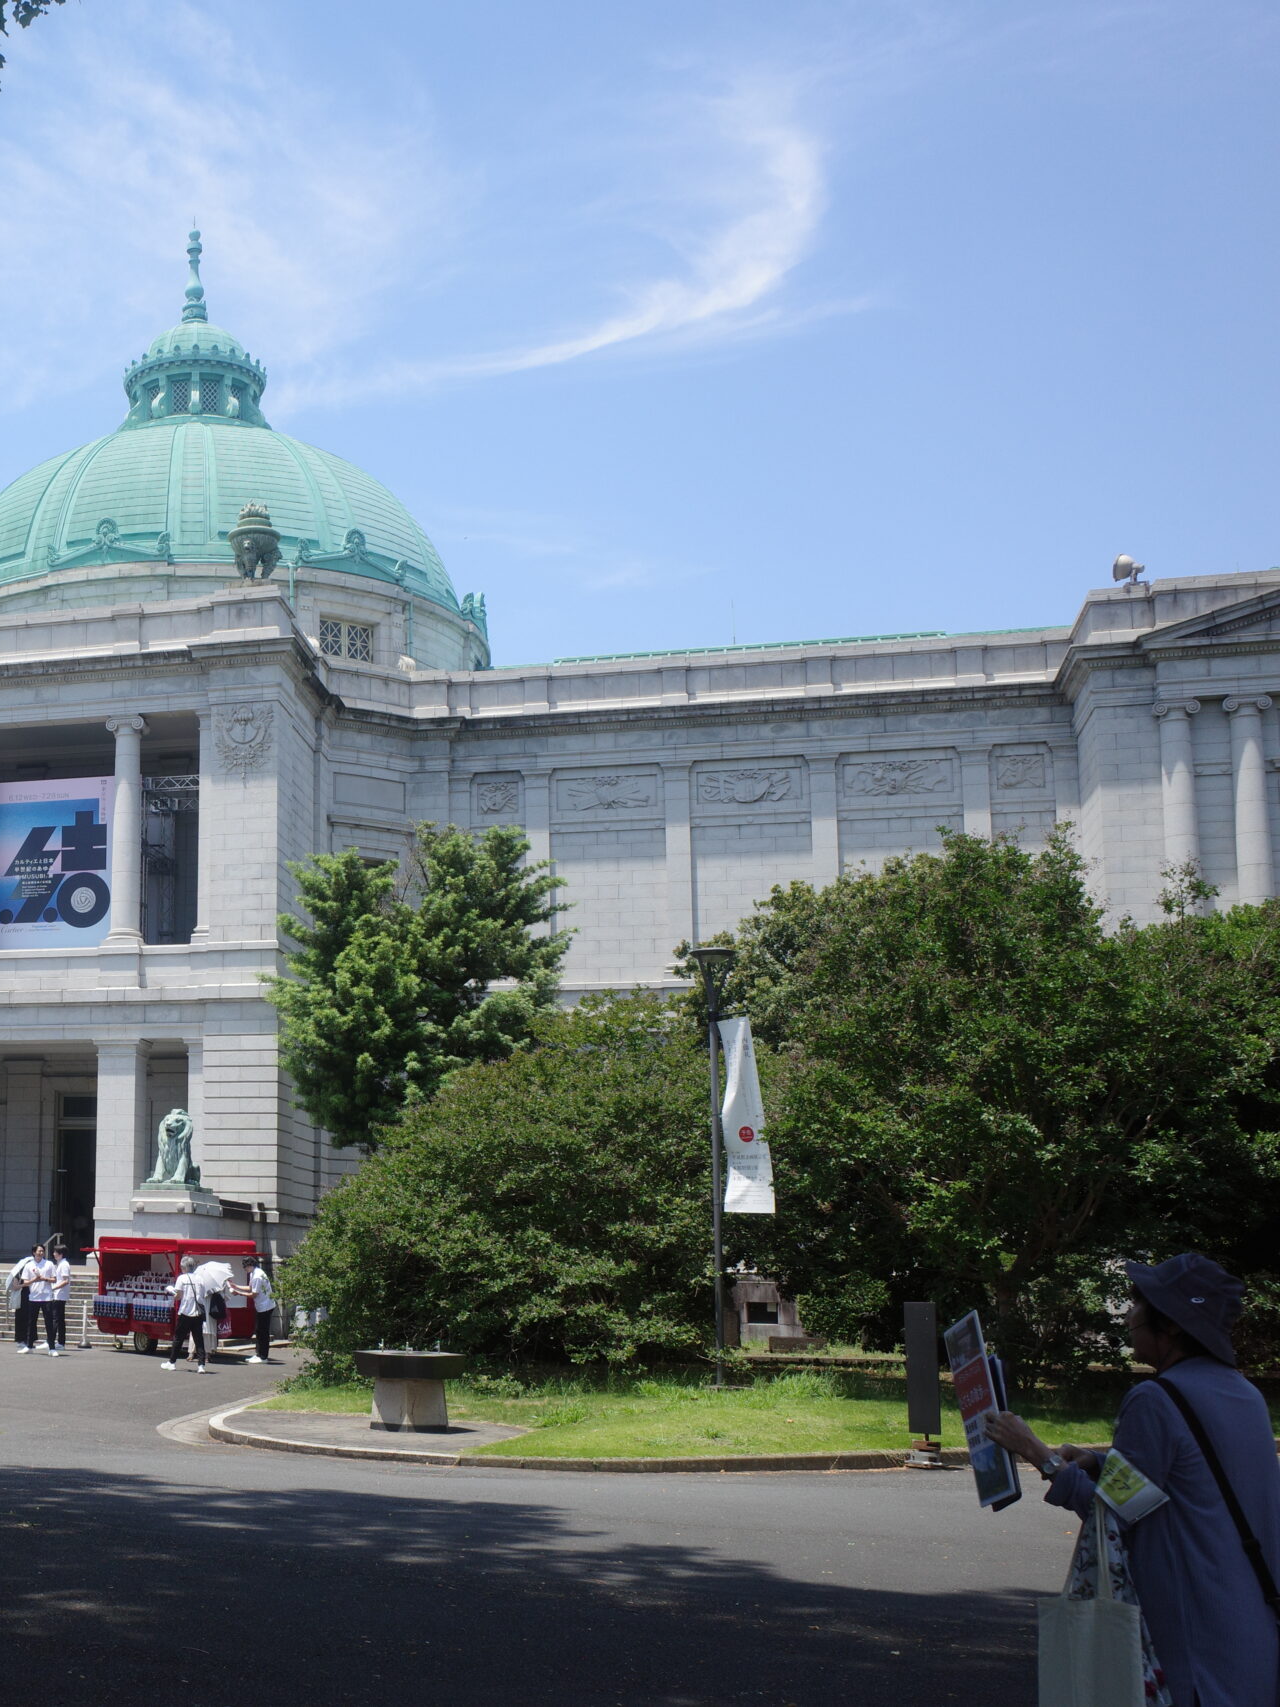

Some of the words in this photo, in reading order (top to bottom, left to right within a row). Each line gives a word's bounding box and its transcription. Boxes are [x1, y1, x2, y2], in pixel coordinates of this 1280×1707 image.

[15, 858, 54, 866] カルティエと日本
